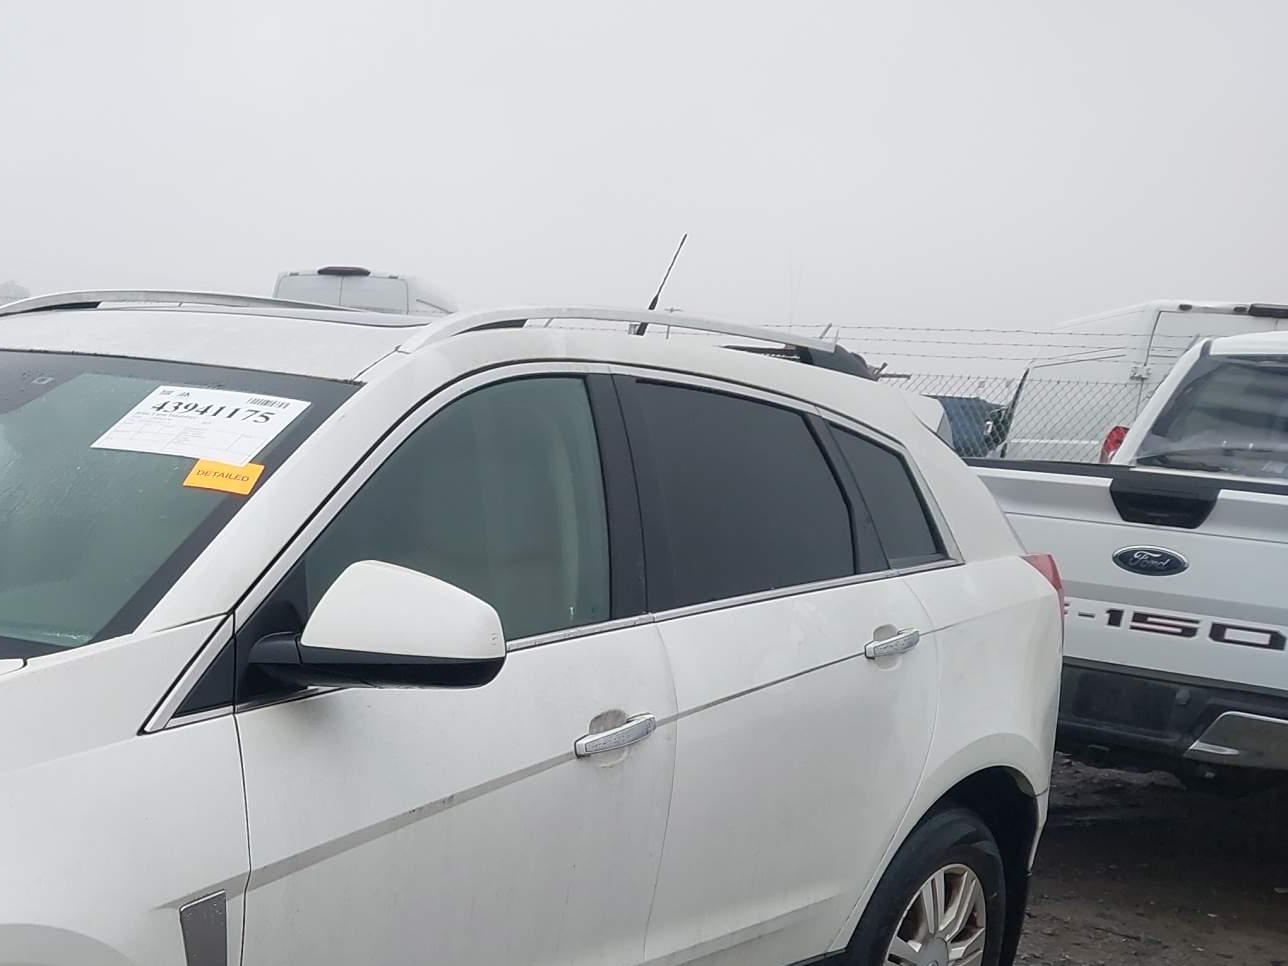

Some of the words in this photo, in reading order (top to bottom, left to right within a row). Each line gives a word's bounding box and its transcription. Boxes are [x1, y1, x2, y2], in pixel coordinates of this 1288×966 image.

[152, 400, 276, 425] 43941175
[197, 469, 250, 483] DETAILED
[1128, 550, 1170, 570] Ford
